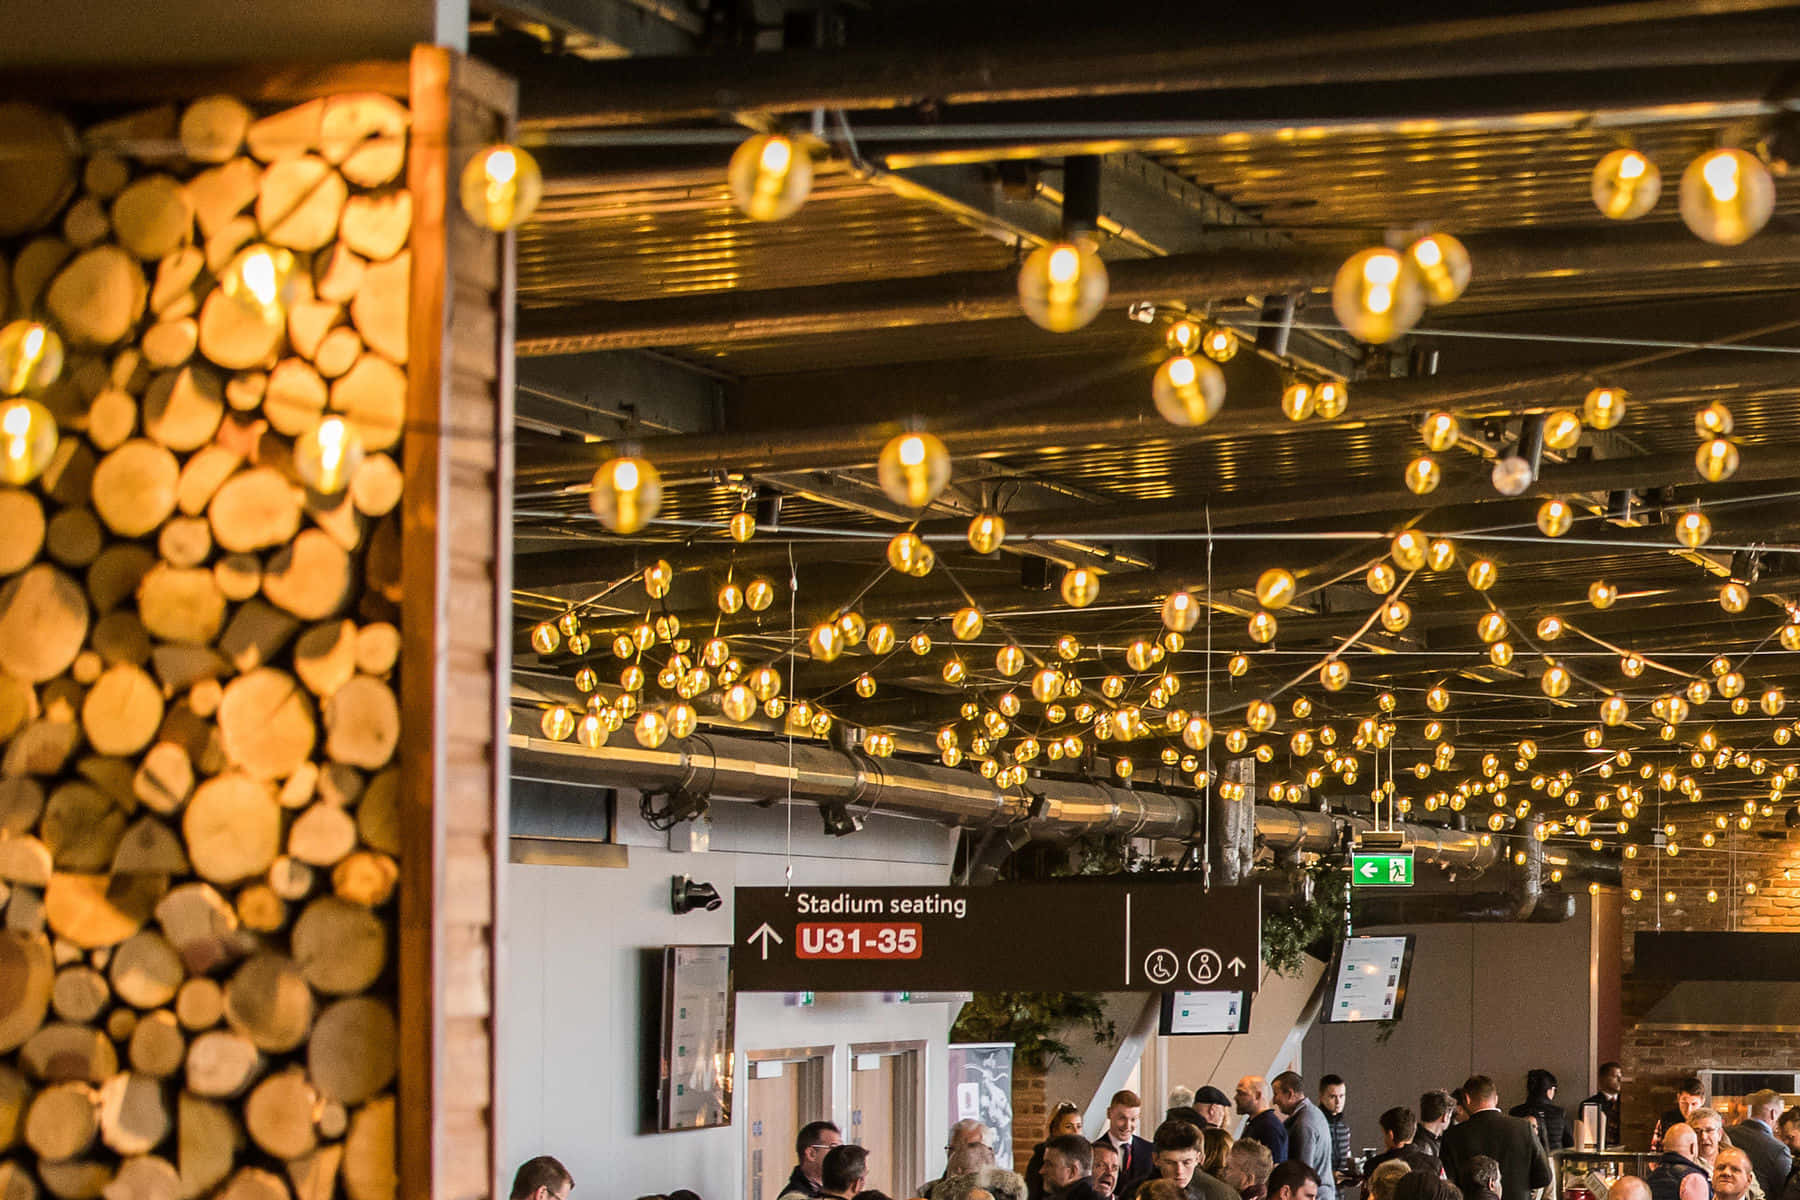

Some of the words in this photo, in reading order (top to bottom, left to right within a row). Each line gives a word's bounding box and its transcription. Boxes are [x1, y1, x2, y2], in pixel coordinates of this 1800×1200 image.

[797, 893, 884, 914] Stadium
[890, 893, 967, 919] seating
[802, 927, 917, 954] U31-35
